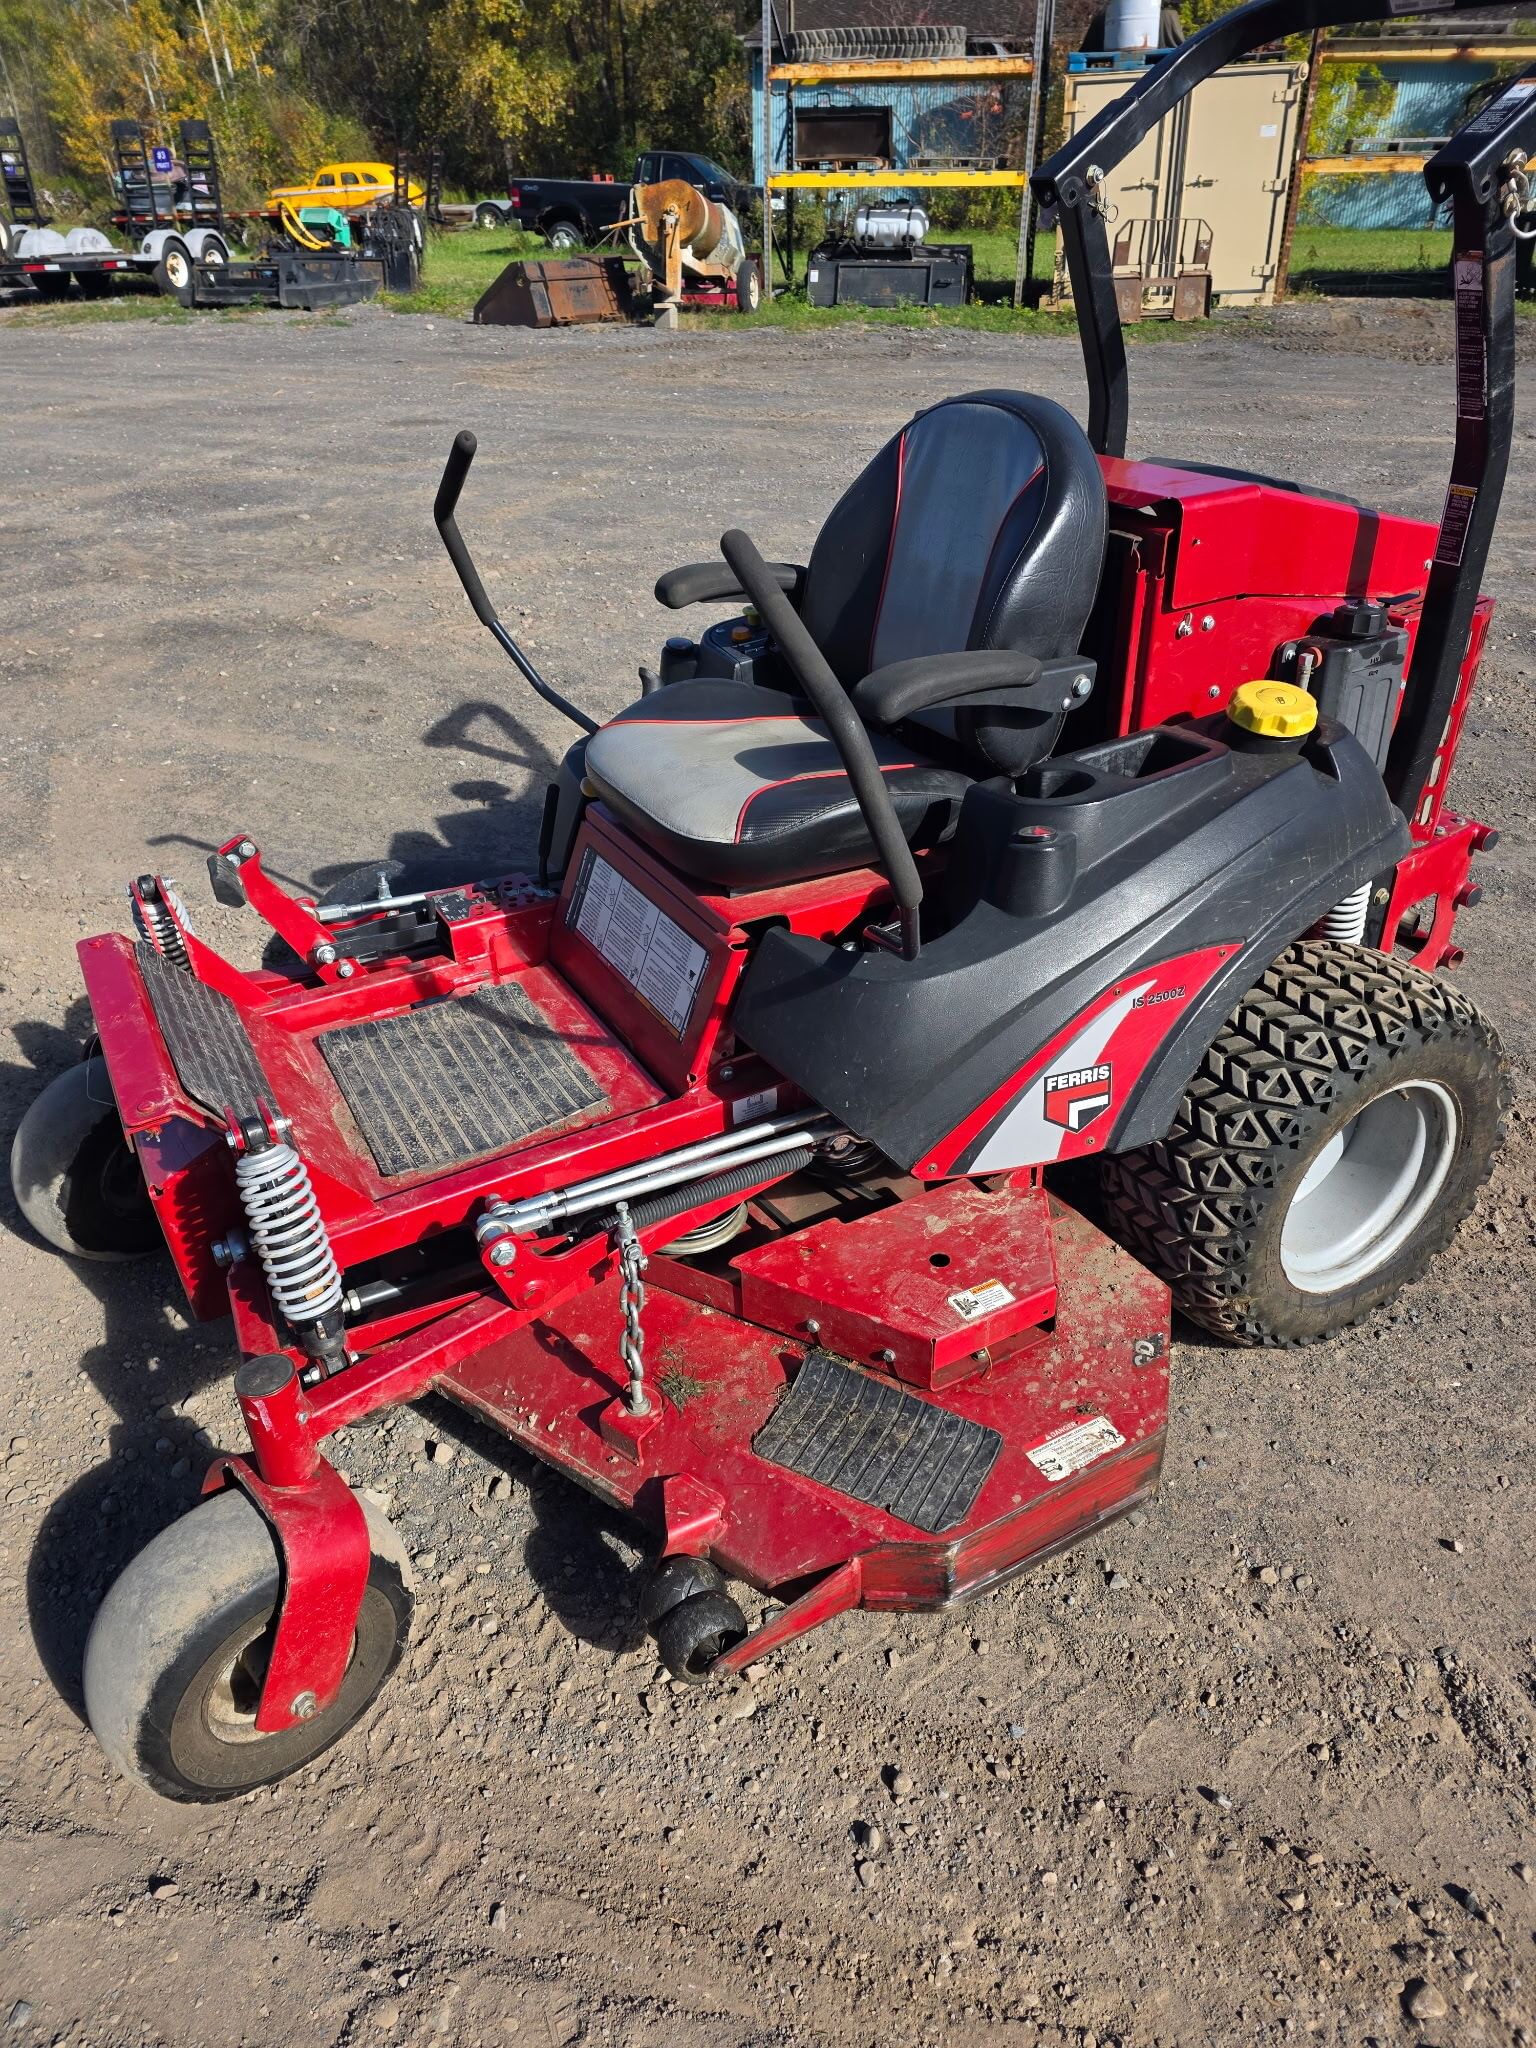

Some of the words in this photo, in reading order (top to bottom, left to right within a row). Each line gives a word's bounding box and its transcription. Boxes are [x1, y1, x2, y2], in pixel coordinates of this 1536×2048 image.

[1132, 996, 1145, 1009] IS
[1147, 986, 1185, 1005] 2500Z
[1046, 1065, 1110, 1092] FERRIS
[1050, 1420, 1078, 1438] DANGER
